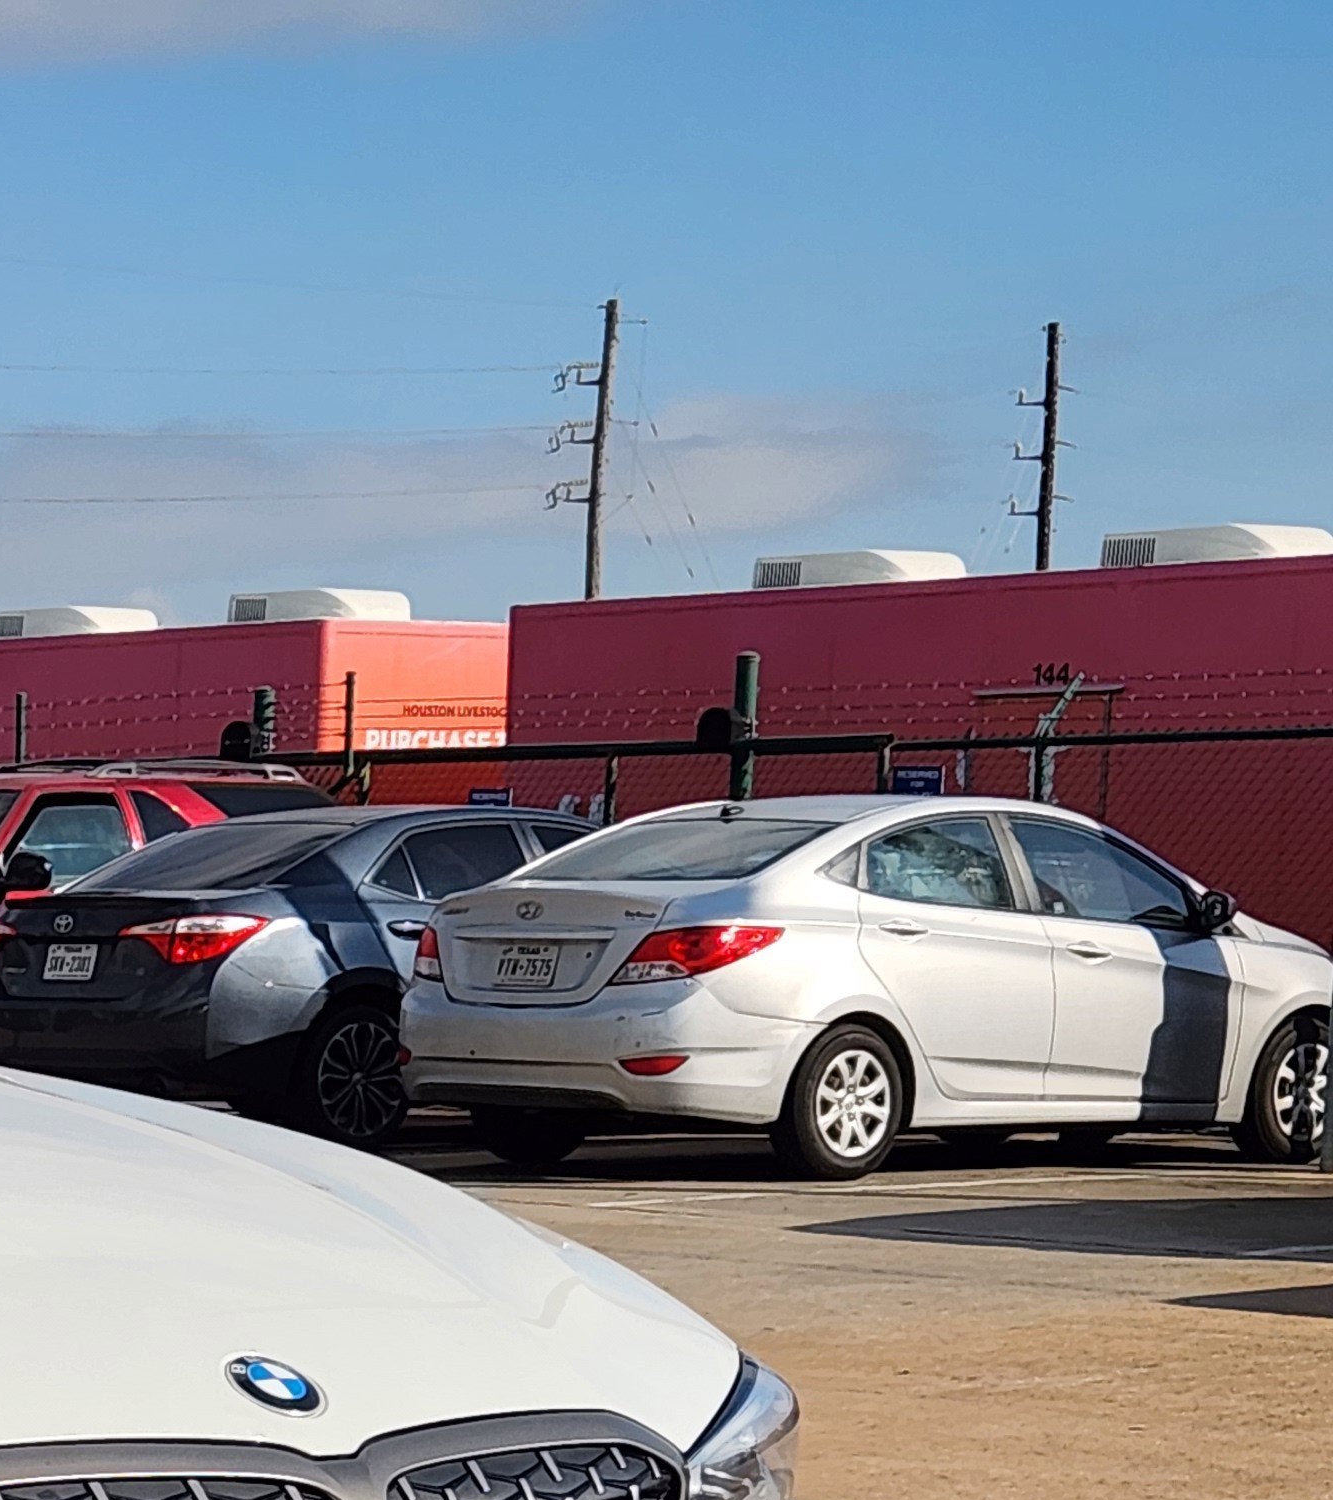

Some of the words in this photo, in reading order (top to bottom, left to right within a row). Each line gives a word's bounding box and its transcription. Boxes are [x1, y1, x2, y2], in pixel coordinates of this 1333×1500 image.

[1032, 662, 1070, 686] 144
[402, 704, 456, 718] HOUSTON
[364, 728, 492, 750] PURCHASE
